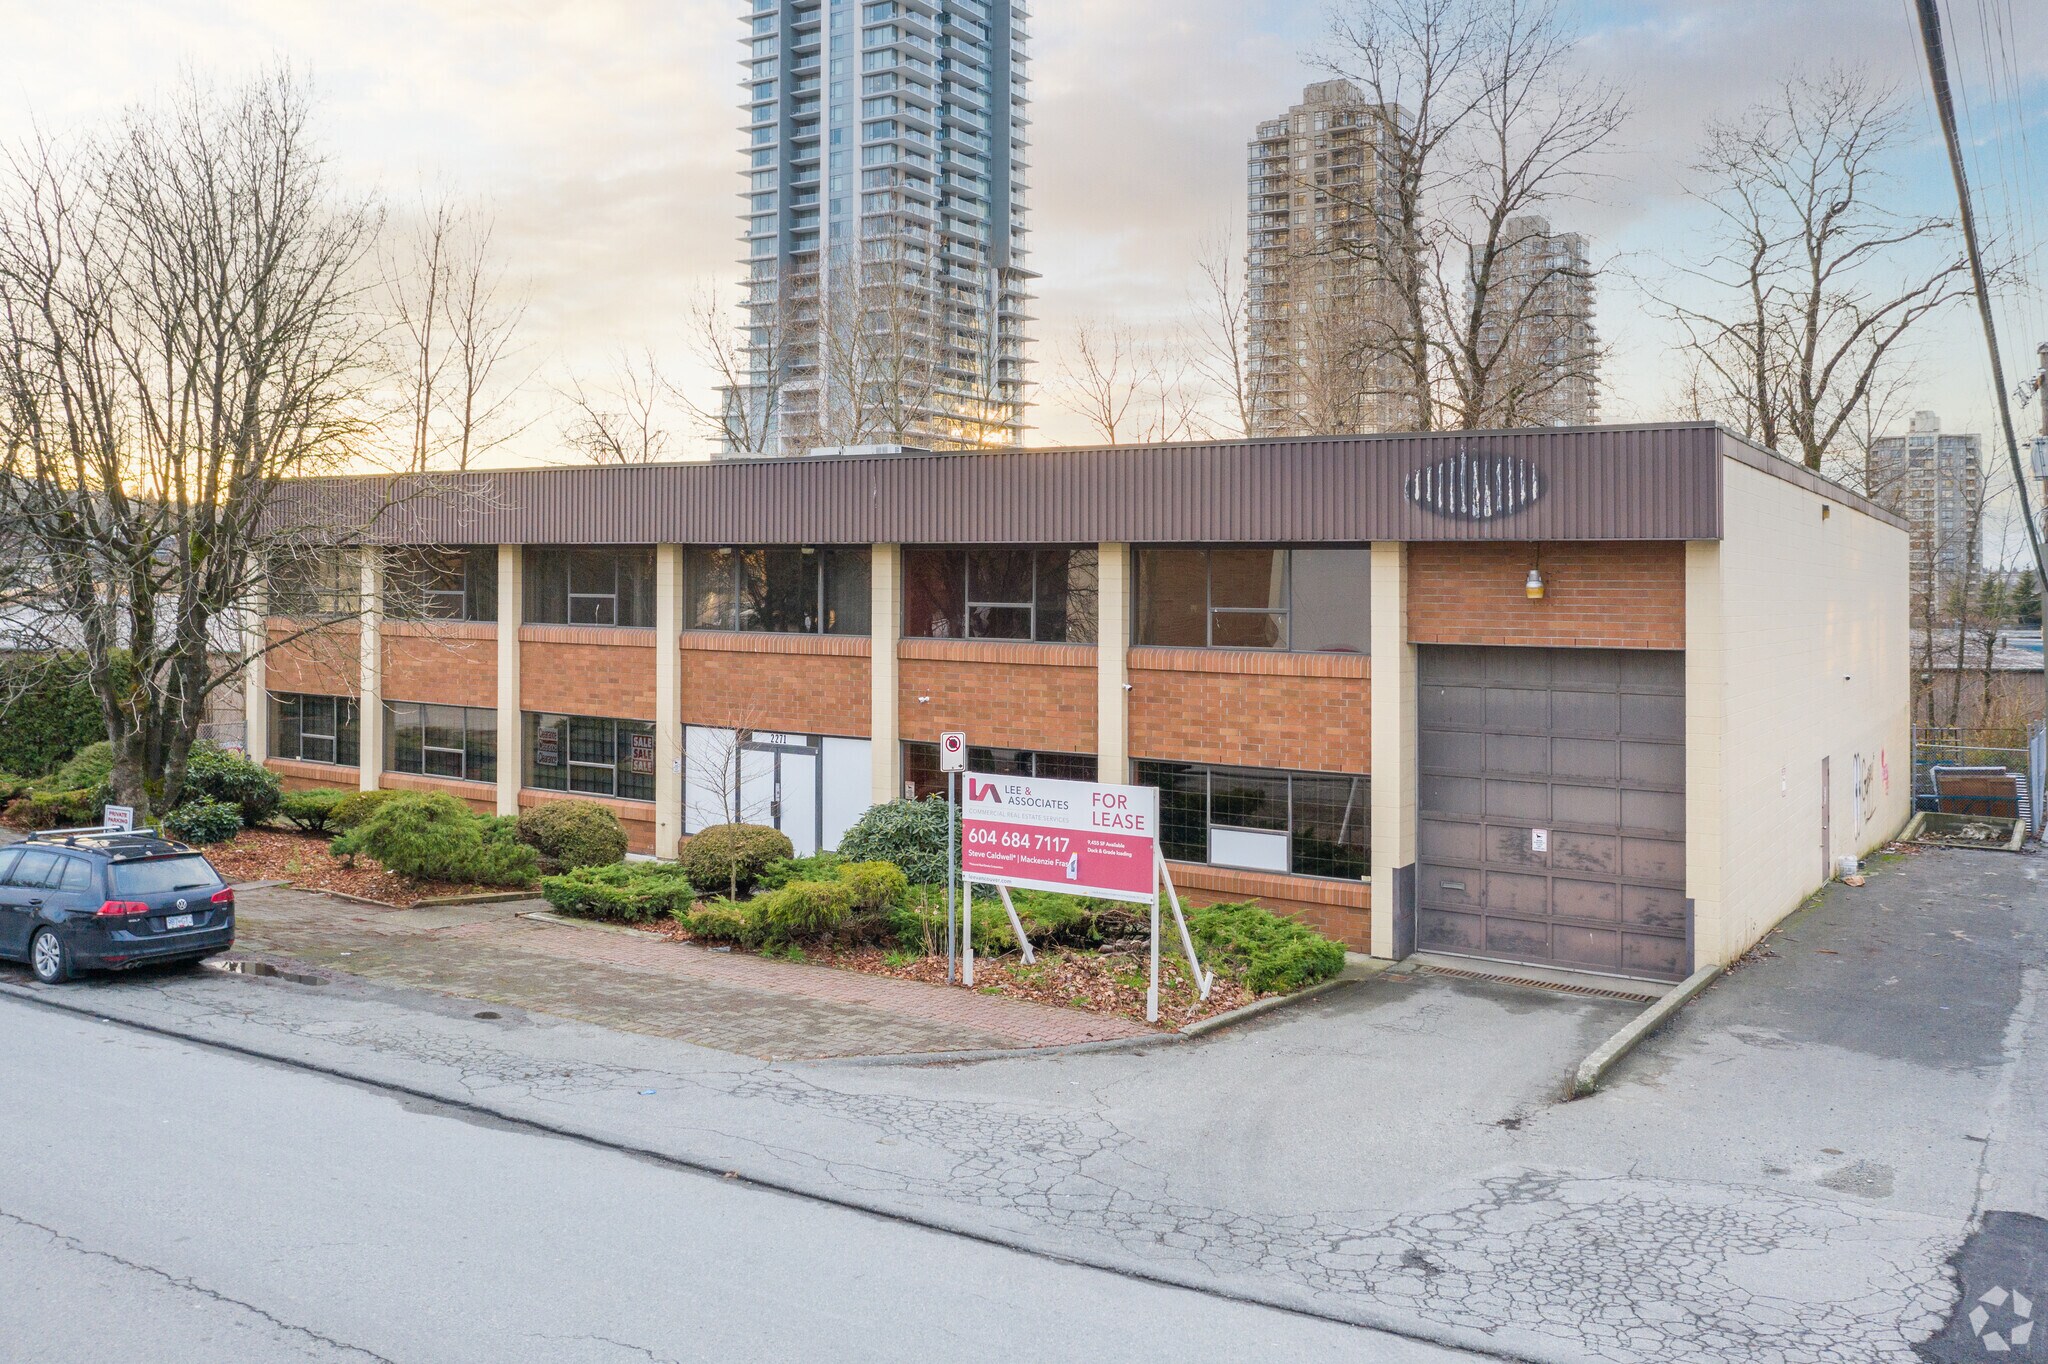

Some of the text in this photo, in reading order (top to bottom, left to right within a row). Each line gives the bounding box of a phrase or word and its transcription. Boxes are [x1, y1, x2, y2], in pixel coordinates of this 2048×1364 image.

[633, 736, 652, 748] SALE
[770, 734, 786, 744] 2271
[633, 748, 652, 760] SALE
[633, 760, 652, 772] SALE
[1005, 785, 1032, 796] LEE &
[1008, 796, 1069, 810] ASSOCIATES
[1092, 792, 1127, 810] FOR
[969, 808, 1006, 818] COMMERCIAL
[1043, 815, 1070, 824] SERVICES
[1092, 811, 1144, 830] LEASE
[968, 828, 1070, 852] 604 684 7117
[968, 849, 985, 858] Steve
[1021, 856, 1054, 866] Mackenzie
